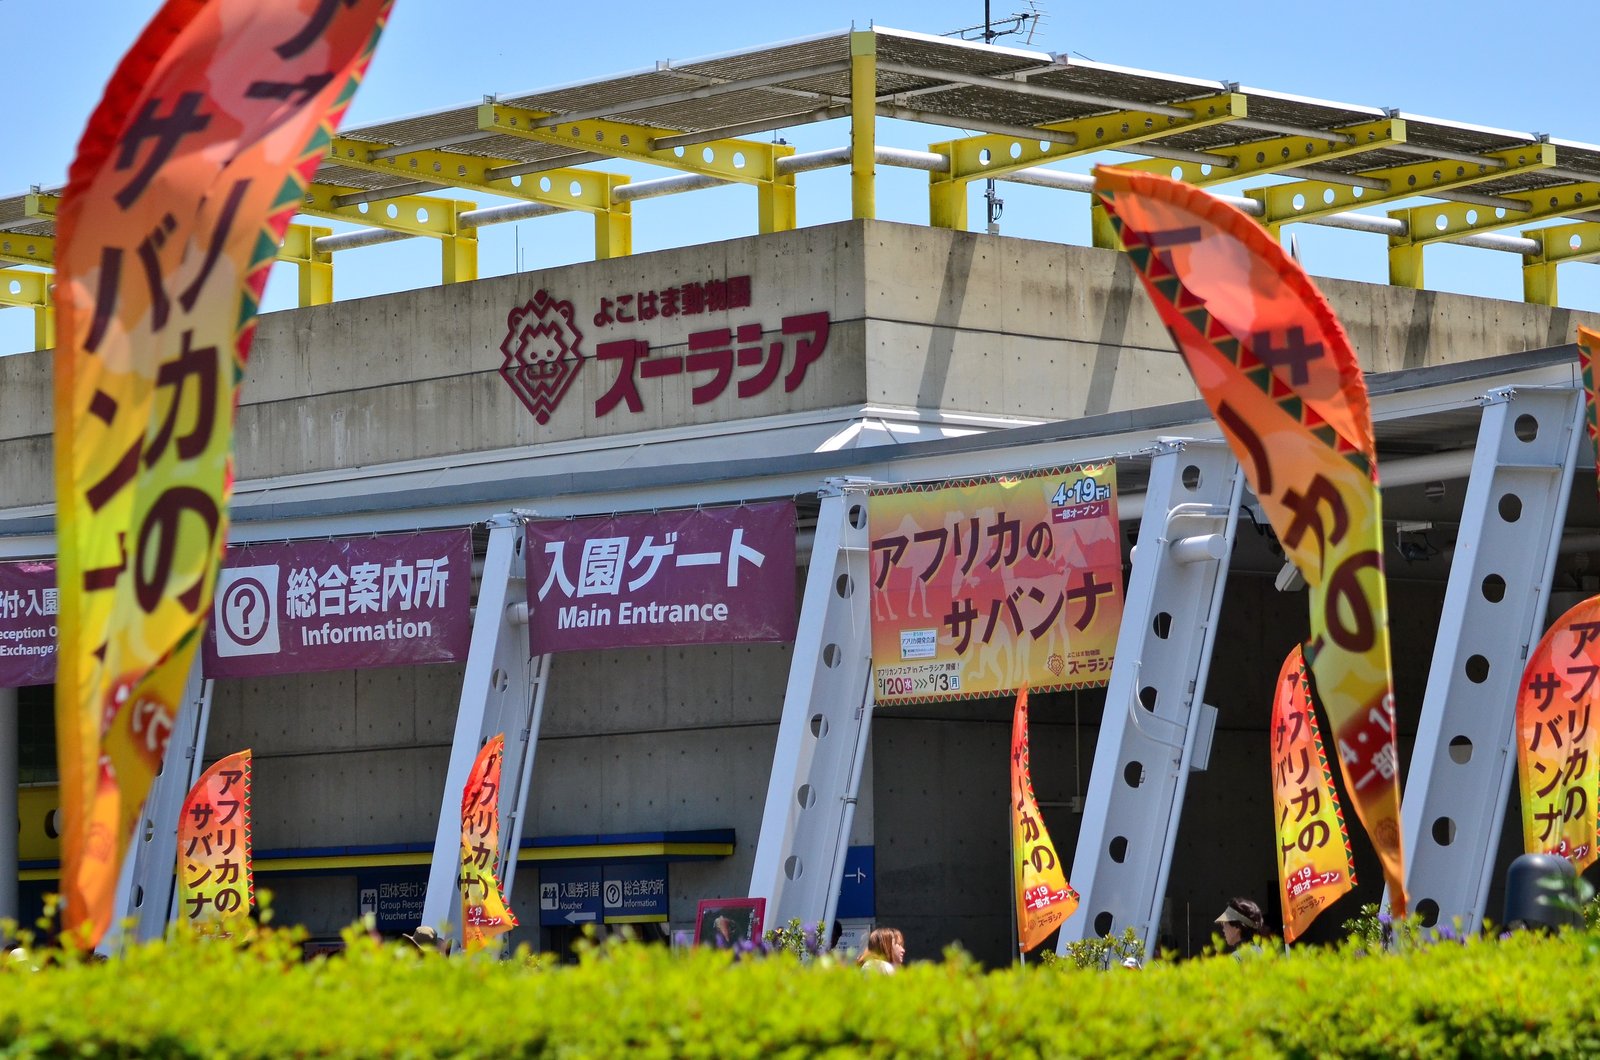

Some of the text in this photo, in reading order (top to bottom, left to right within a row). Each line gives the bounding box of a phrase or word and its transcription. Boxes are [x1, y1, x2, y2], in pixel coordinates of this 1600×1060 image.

[593, 275, 752, 327] よこはま動物園
[595, 311, 829, 418] ズーラシア
[537, 528, 766, 602] 入園ゲート
[872, 512, 1053, 589] アフリカの
[286, 556, 449, 619] 総合案内所
[0, 588, 61, 619] 付・入園
[557, 602, 729, 630] Main Entrance
[944, 571, 1114, 655] サバンナ
[0, 627, 46, 641] eception
[302, 617, 432, 646] Information
[0, 644, 54, 657] Exchange
[1287, 672, 1331, 852] アフリカの
[1529, 673, 1563, 842] サバンナ
[215, 770, 244, 913] アフリカの
[185, 803, 214, 919] サバンナ
[560, 881, 600, 898] 入園券引替
[623, 879, 664, 896] 総合案内所
[624, 898, 657, 908] Information
[380, 901, 400, 911] Group
[380, 911, 407, 920] Voucher
[560, 901, 582, 910] Voucher
